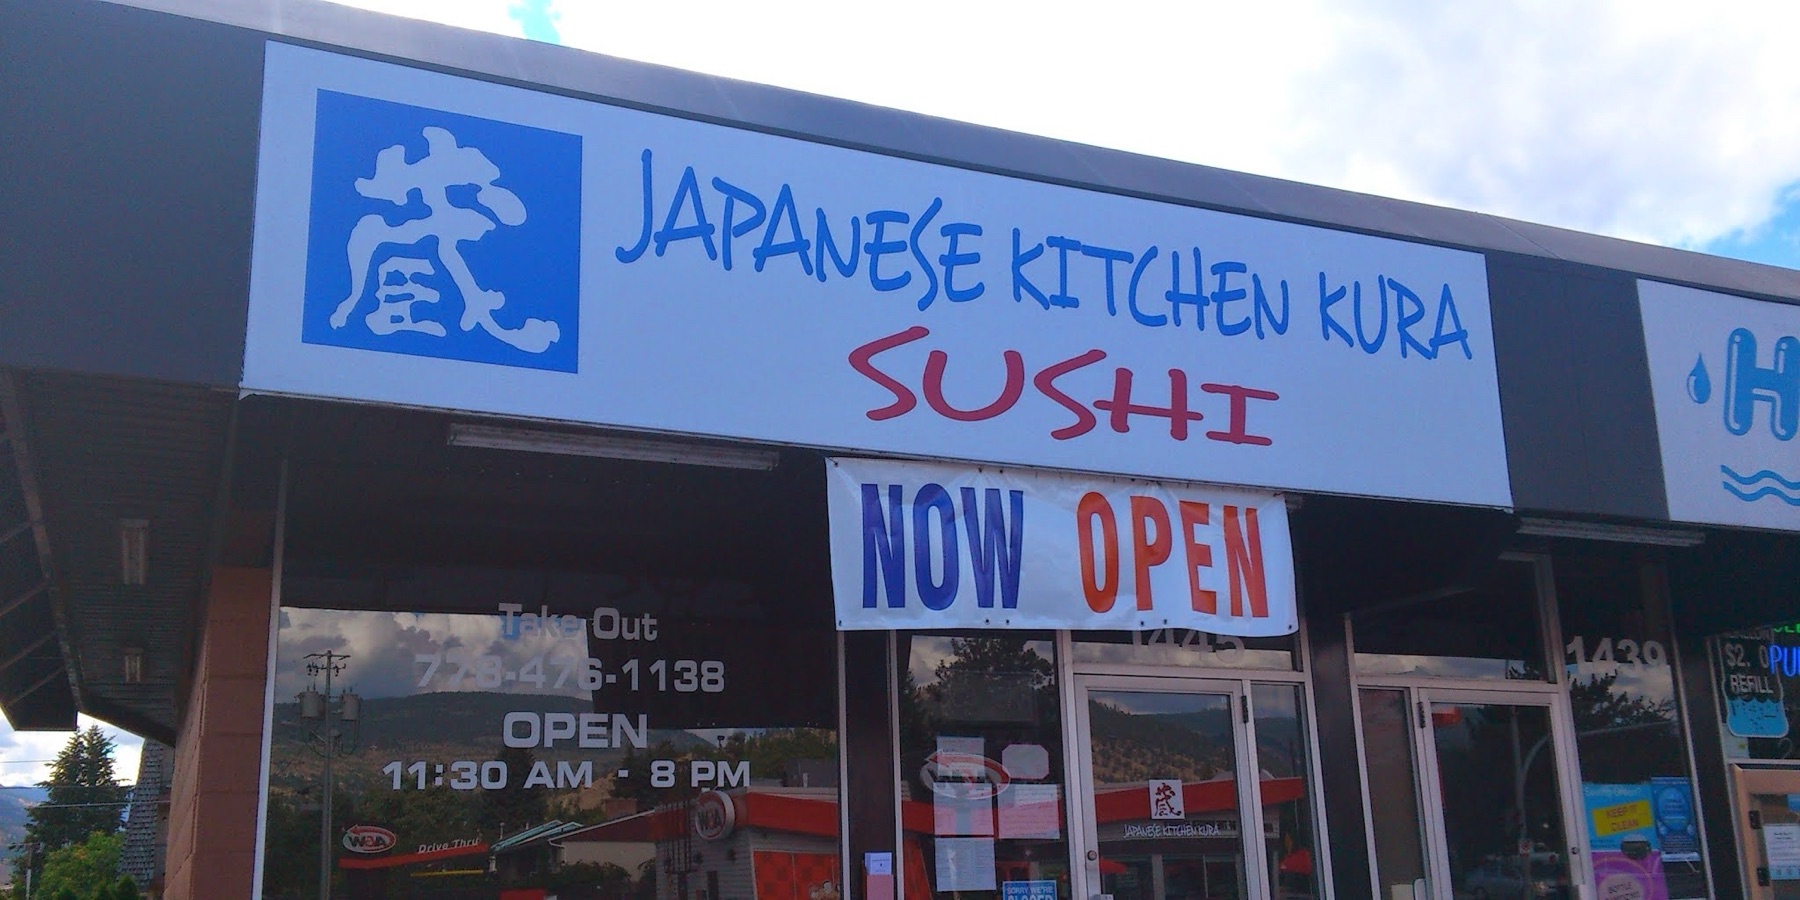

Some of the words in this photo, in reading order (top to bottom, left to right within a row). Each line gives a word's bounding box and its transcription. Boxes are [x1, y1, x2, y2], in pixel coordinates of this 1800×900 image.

[616, 148, 984, 311] JAPANESE
[1011, 227, 1289, 340] KITCHEN
[1318, 271, 1472, 361] KURA
[848, 325, 1280, 446] SUSHI
[861, 482, 1024, 611] NOW
[1075, 491, 1270, 618] OPEN
[498, 602, 581, 638] Take
[592, 606, 658, 641] Out
[1132, 628, 1246, 665] 1445
[1566, 635, 1668, 678] 1439
[1769, 644, 1800, 677] PU
[414, 653, 726, 693] 778-476-1138
[1730, 673, 1774, 694] REFILL
[502, 711, 648, 749] OPEN
[381, 760, 508, 790] 11:30
[522, 760, 593, 789] AM
[650, 759, 676, 788] 8
[690, 760, 751, 789] PM
[417, 843, 449, 855] Drive
[453, 837, 479, 848] Thru
[1123, 822, 1161, 839] JAPANESE
[1162, 821, 1197, 838] KITCHEN
[1198, 820, 1221, 838] KURA
[1007, 886, 1029, 895] SORRY
[1030, 885, 1054, 894] WE'RE
